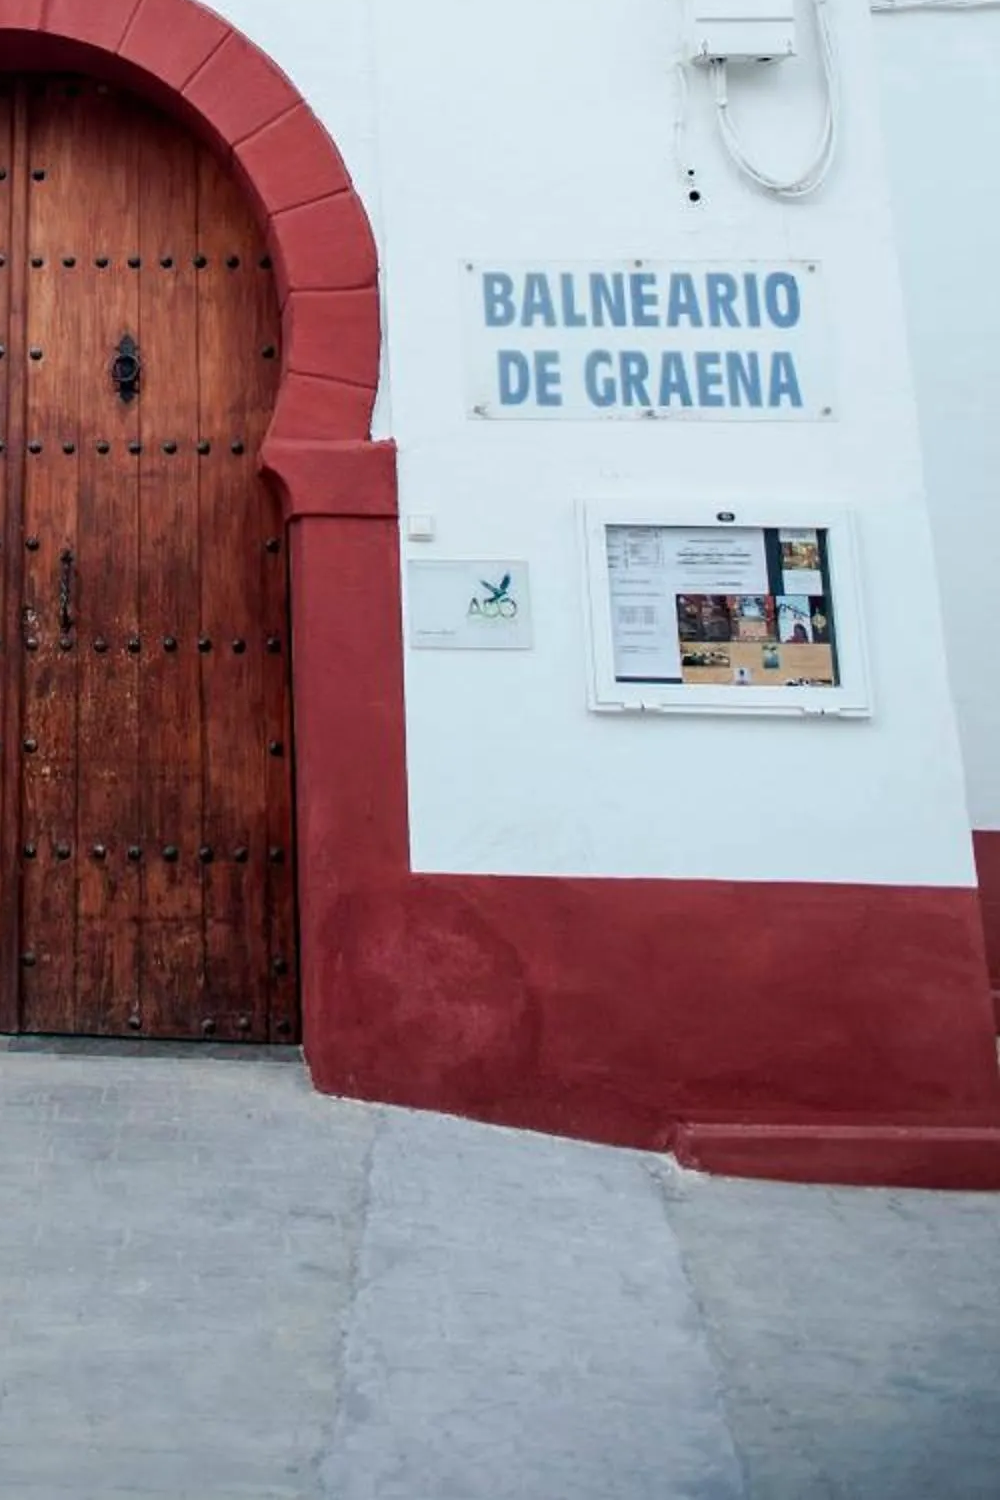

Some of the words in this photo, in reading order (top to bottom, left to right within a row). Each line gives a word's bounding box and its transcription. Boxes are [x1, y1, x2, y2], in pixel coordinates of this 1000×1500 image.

[482, 272, 801, 329] BALNEARIO
[497, 349, 562, 406] DE
[584, 349, 803, 407] GRAENA
